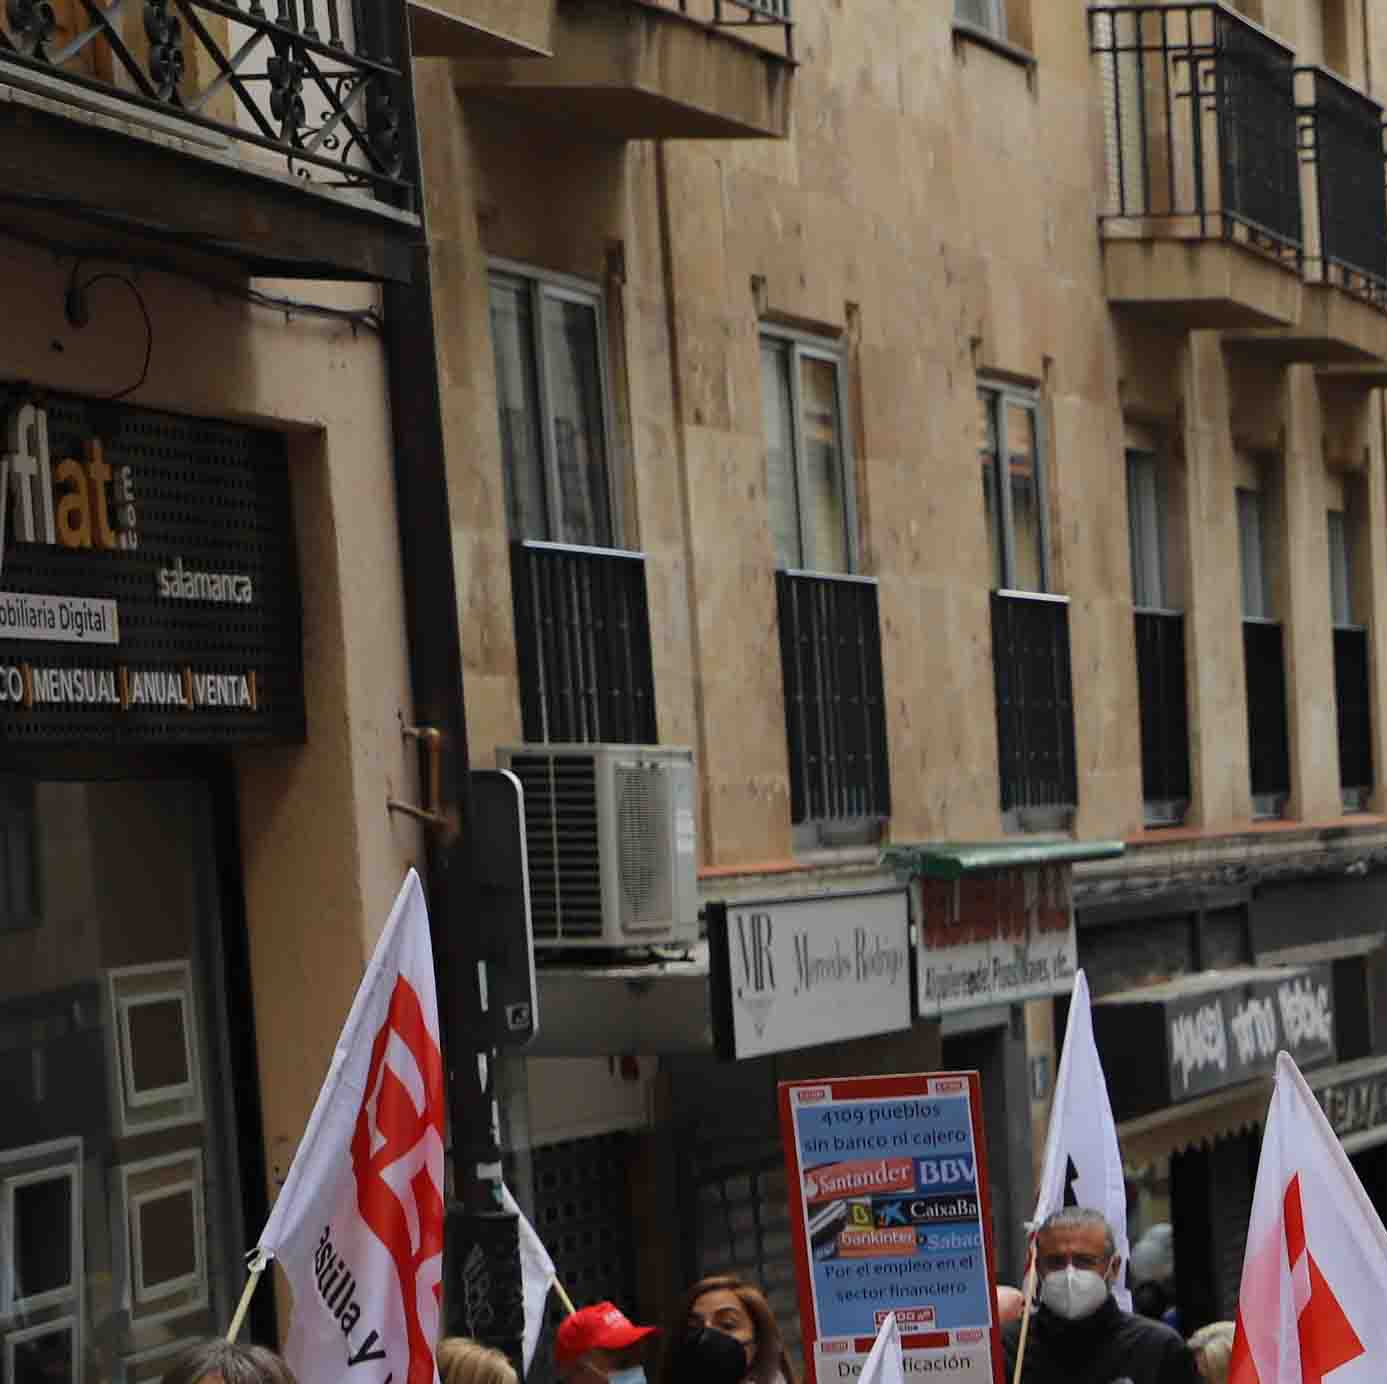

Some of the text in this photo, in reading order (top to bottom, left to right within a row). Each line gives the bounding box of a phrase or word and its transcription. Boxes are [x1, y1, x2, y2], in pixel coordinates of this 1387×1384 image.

[157, 556, 252, 603] salamanca
[59, 602, 107, 637] Digital
[33, 667, 121, 703] MENSUAL
[131, 668, 188, 705] ANUAL
[194, 673, 252, 707] VENTA
[820, 1102, 941, 1128] 4109 pueblos
[803, 1128, 967, 1153] sin banco ni cajero
[818, 1161, 911, 1195] Santander
[910, 1200, 978, 1219] CaixaBa
[824, 1256, 974, 1280] Por el empleo en el
[834, 1281, 967, 1303] sector financiero
[347, 1330, 387, 1367] y
